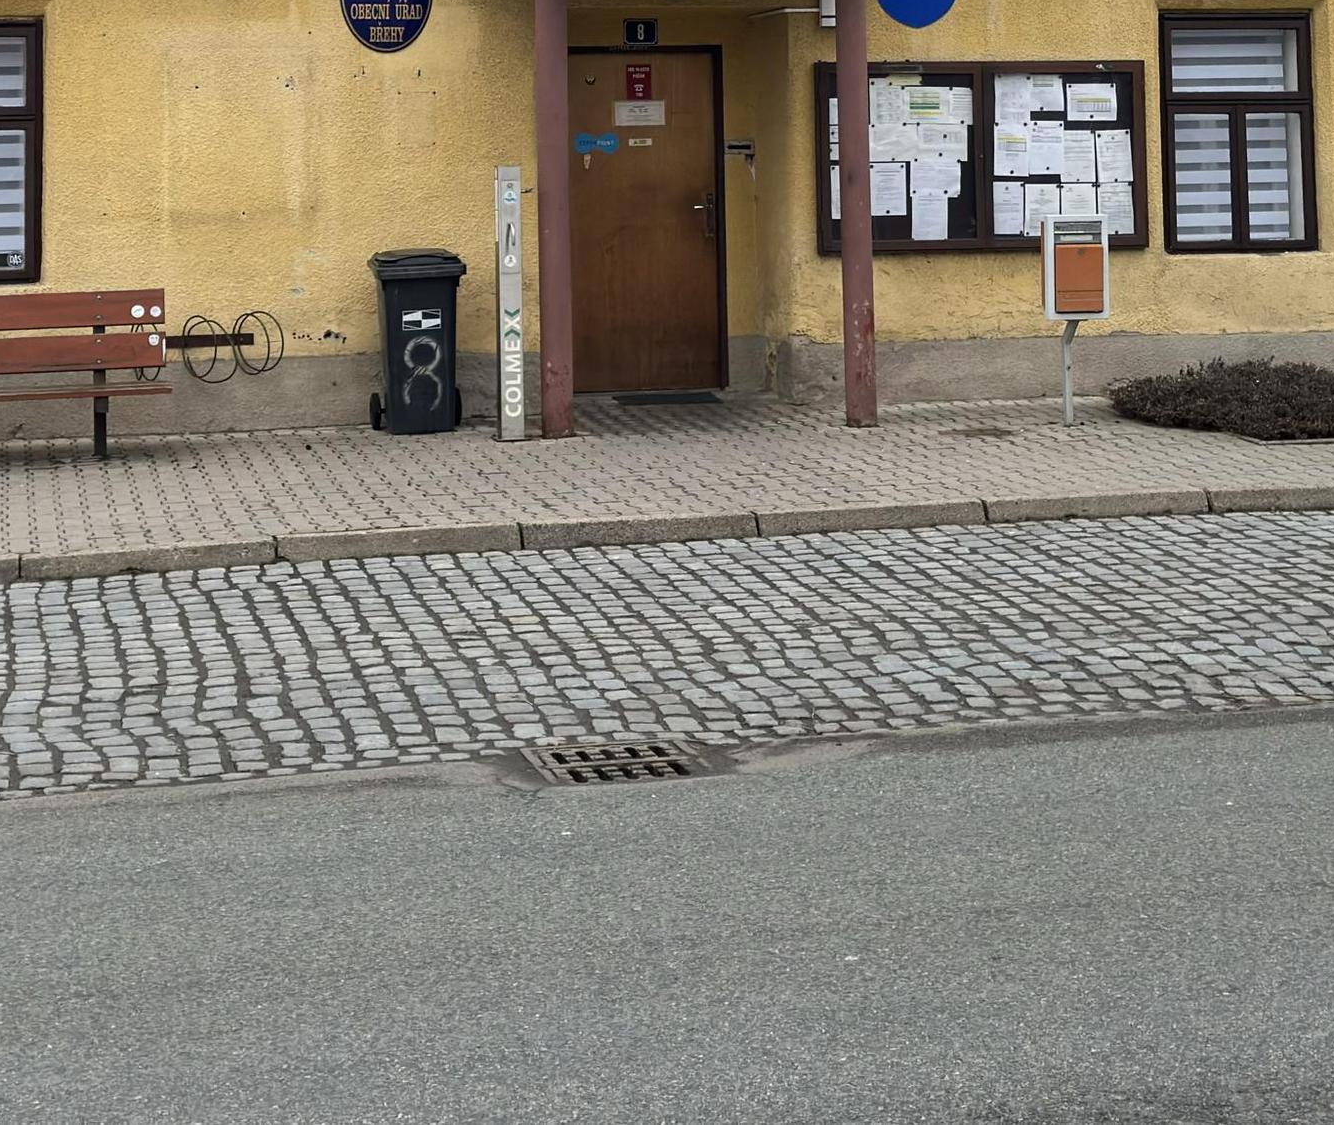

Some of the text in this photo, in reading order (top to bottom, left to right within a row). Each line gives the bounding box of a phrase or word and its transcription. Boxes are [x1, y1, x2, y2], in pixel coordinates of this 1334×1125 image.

[369, 21, 405, 43] BŘEHY
[637, 23, 645, 40] 8
[504, 308, 522, 417] COLMEX
